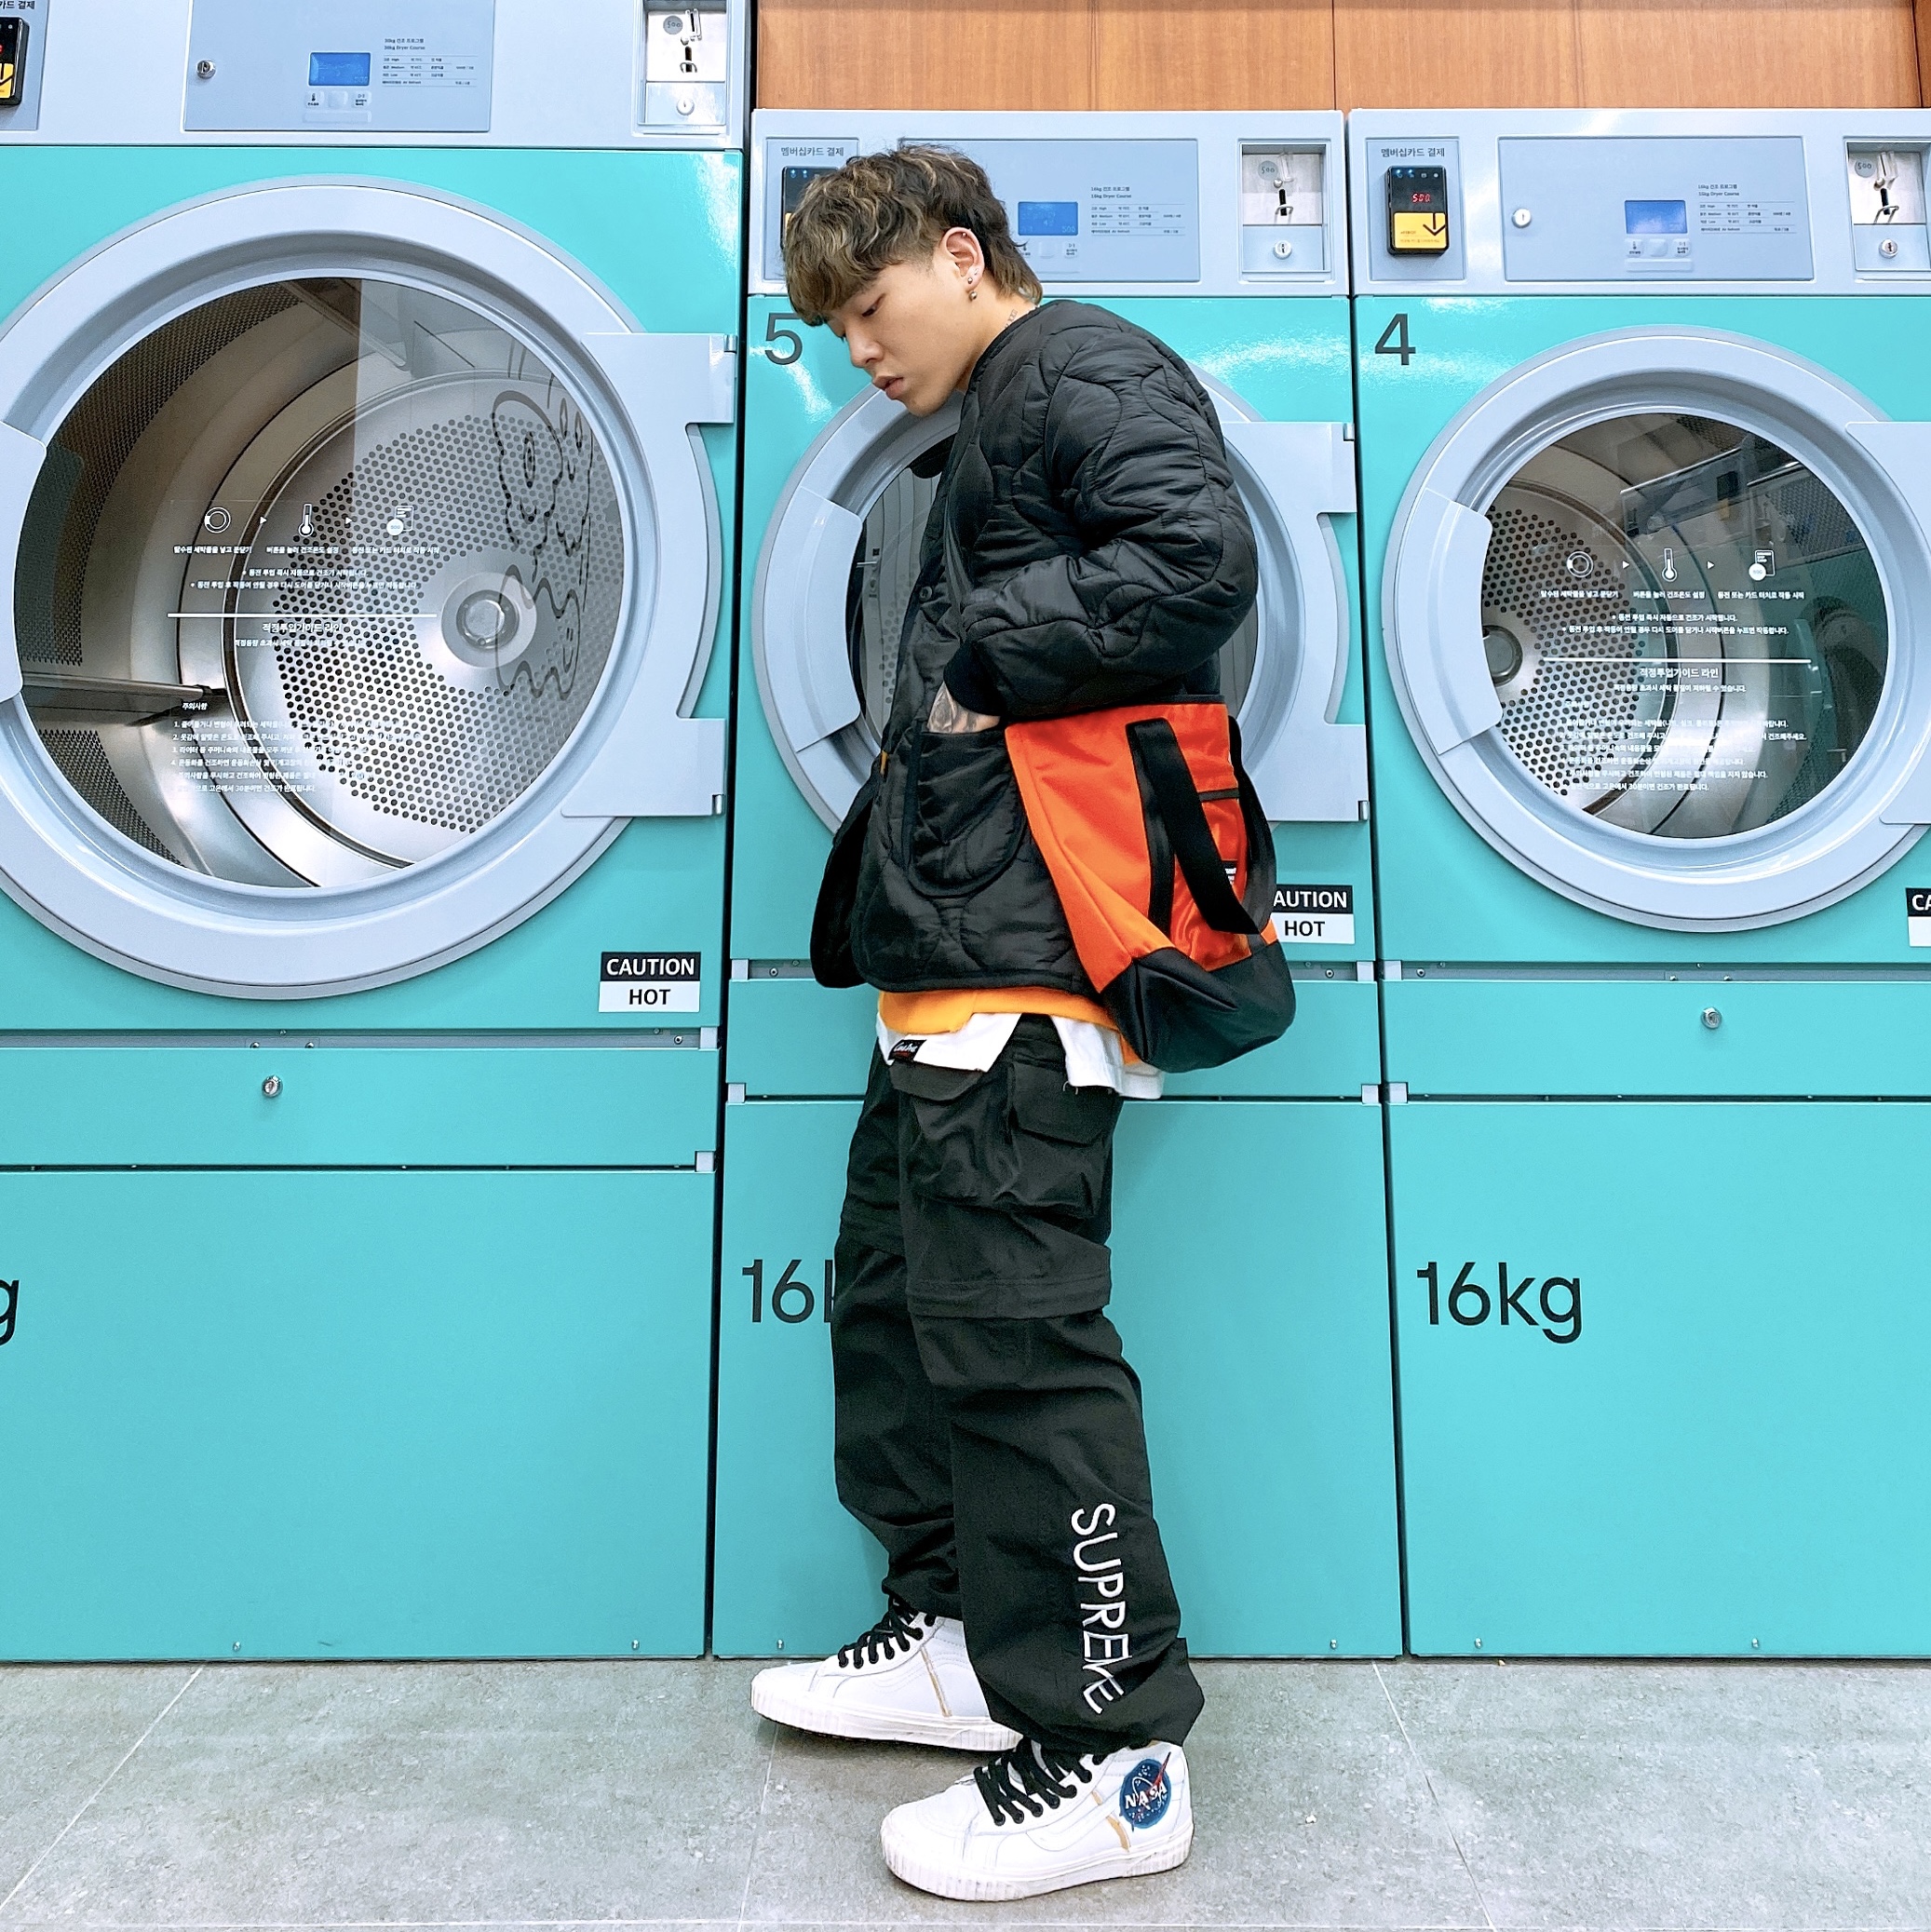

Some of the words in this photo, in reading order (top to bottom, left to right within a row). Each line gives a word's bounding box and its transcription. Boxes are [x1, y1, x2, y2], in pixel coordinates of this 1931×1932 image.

[19, 0, 34, 9] 결제
[781, 147, 824, 156] 멤버십카드
[827, 147, 844, 156] 결제
[1382, 148, 1425, 157] 멤버십카드
[1428, 148, 1445, 157] 결제
[765, 312, 803, 365] 5
[1374, 313, 1416, 366] 4
[1274, 890, 1347, 909] AUTION
[1285, 920, 1325, 937] HOT
[607, 958, 695, 976] CAUTION
[629, 989, 671, 1006] HOT
[742, 1259, 834, 1324] 16
[1417, 1262, 1583, 1344] 16kg
[1071, 1503, 1133, 1714] SUPREME
[1125, 1780, 1168, 1809] NASA
